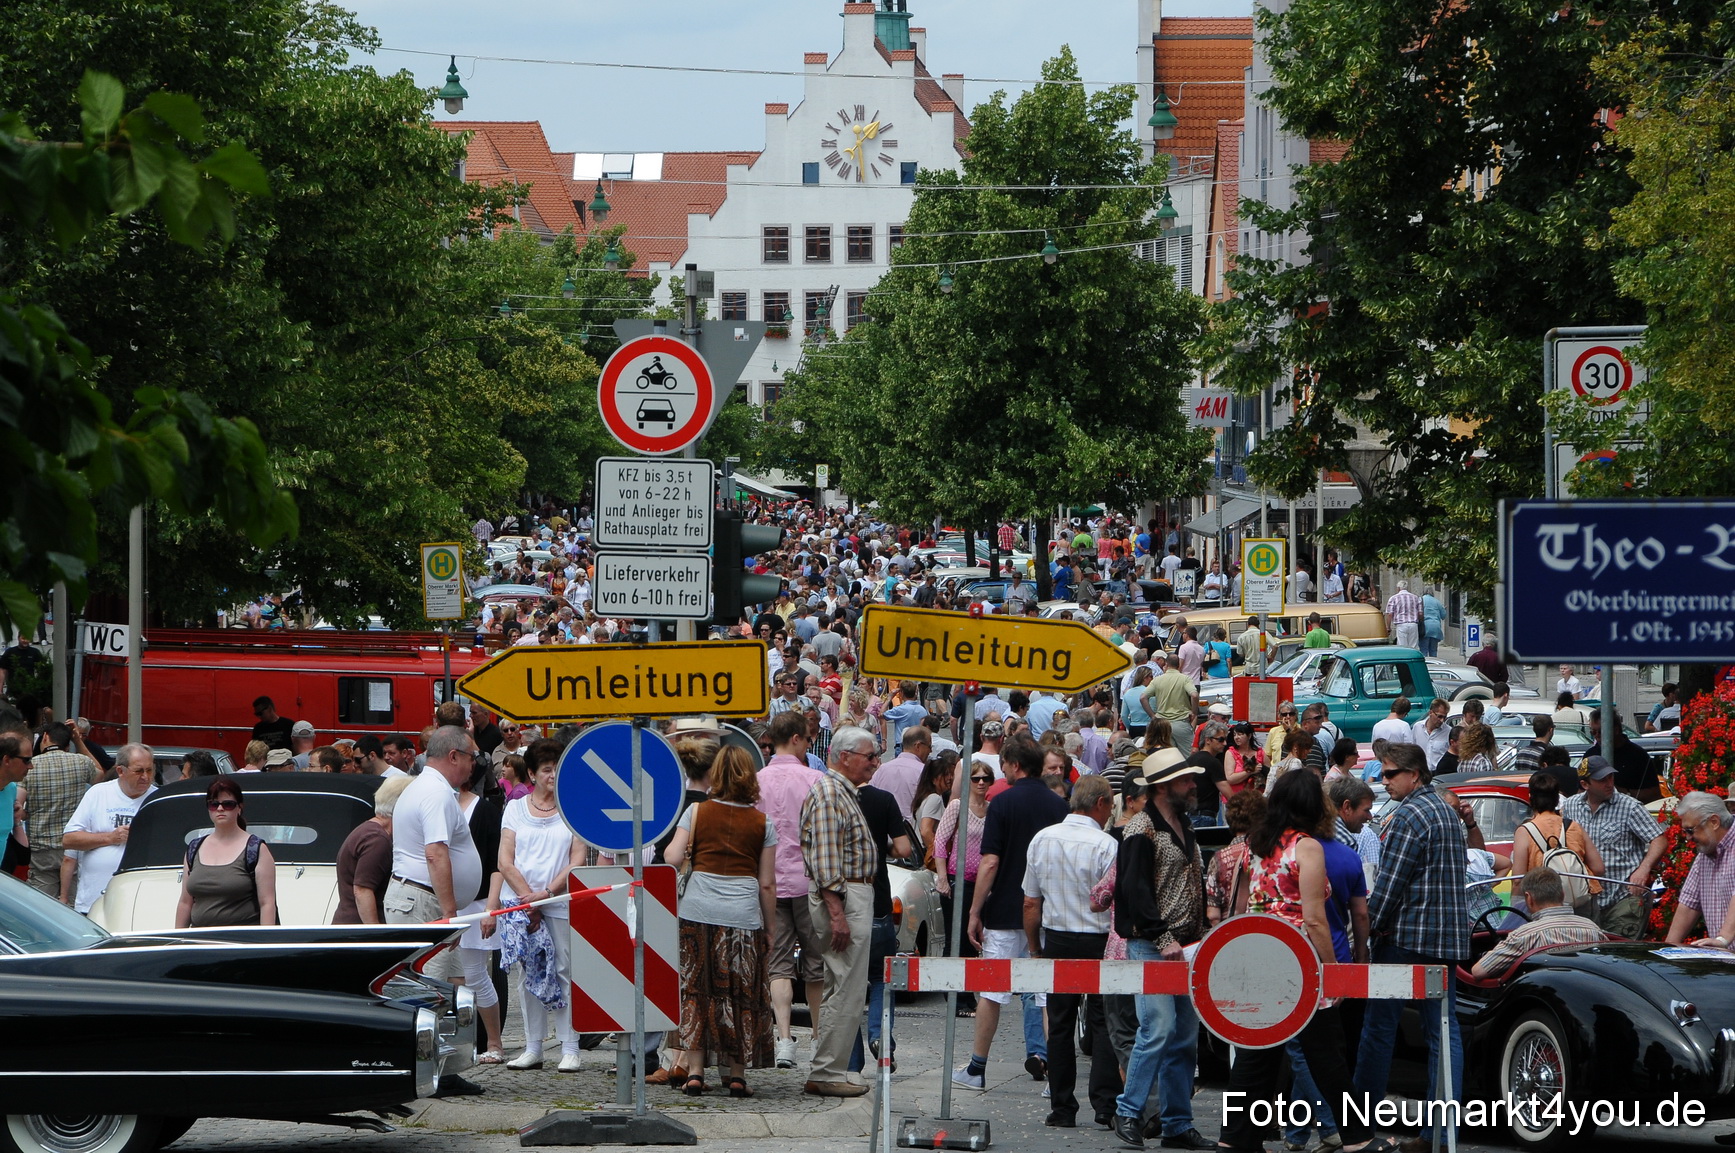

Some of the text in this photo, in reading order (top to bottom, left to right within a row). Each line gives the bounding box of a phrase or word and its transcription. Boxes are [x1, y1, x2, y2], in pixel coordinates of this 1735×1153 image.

[1585, 362, 1620, 390] 30
[1195, 396, 1228, 419] H&M
[618, 468, 692, 484] KFZ bis 3,5 t
[619, 488, 639, 500] von
[684, 487, 691, 500] h
[606, 504, 703, 522] und Anlieger bis
[604, 521, 704, 539] Rathausplatz frei
[435, 556, 449, 573] H
[1256, 552, 1270, 568] H
[606, 564, 700, 582] Lieferverkehr
[602, 592, 626, 604] von
[666, 590, 673, 605] h
[679, 590, 702, 606] frei
[90, 626, 124, 652] WC
[1470, 628, 1477, 638] P
[1689, 621, 1734, 642] 1945
[877, 625, 1072, 681] Umleitung
[526, 664, 732, 706] Umleitung
